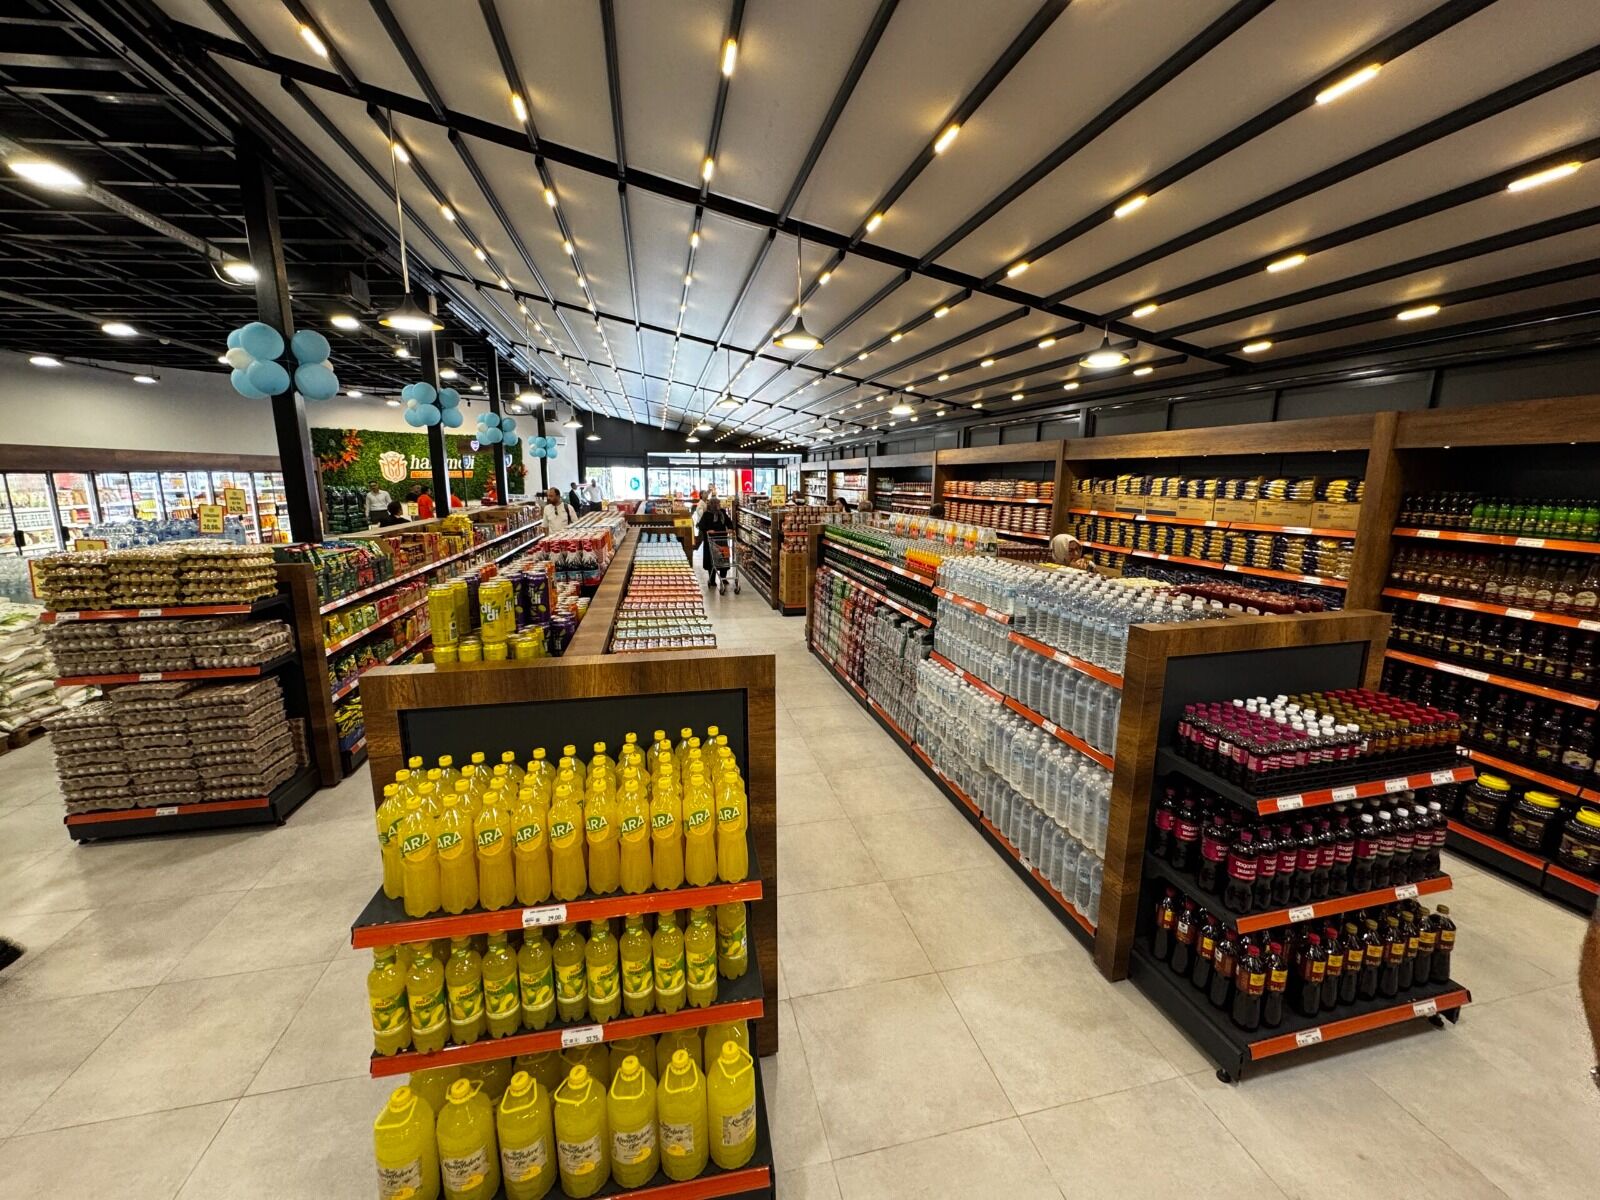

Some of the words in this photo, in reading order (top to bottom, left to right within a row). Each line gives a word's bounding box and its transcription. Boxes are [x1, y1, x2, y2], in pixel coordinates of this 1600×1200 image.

[652, 813, 674, 828] ARA
[688, 809, 711, 826] ARA
[718, 807, 740, 821] ARA
[550, 821, 575, 837] ARA
[586, 816, 608, 829] ARA
[621, 816, 645, 832] ARA
[437, 831, 462, 849] ARA
[477, 827, 503, 845] ARA
[515, 823, 541, 842] ARA
[403, 831, 431, 853] ARA
